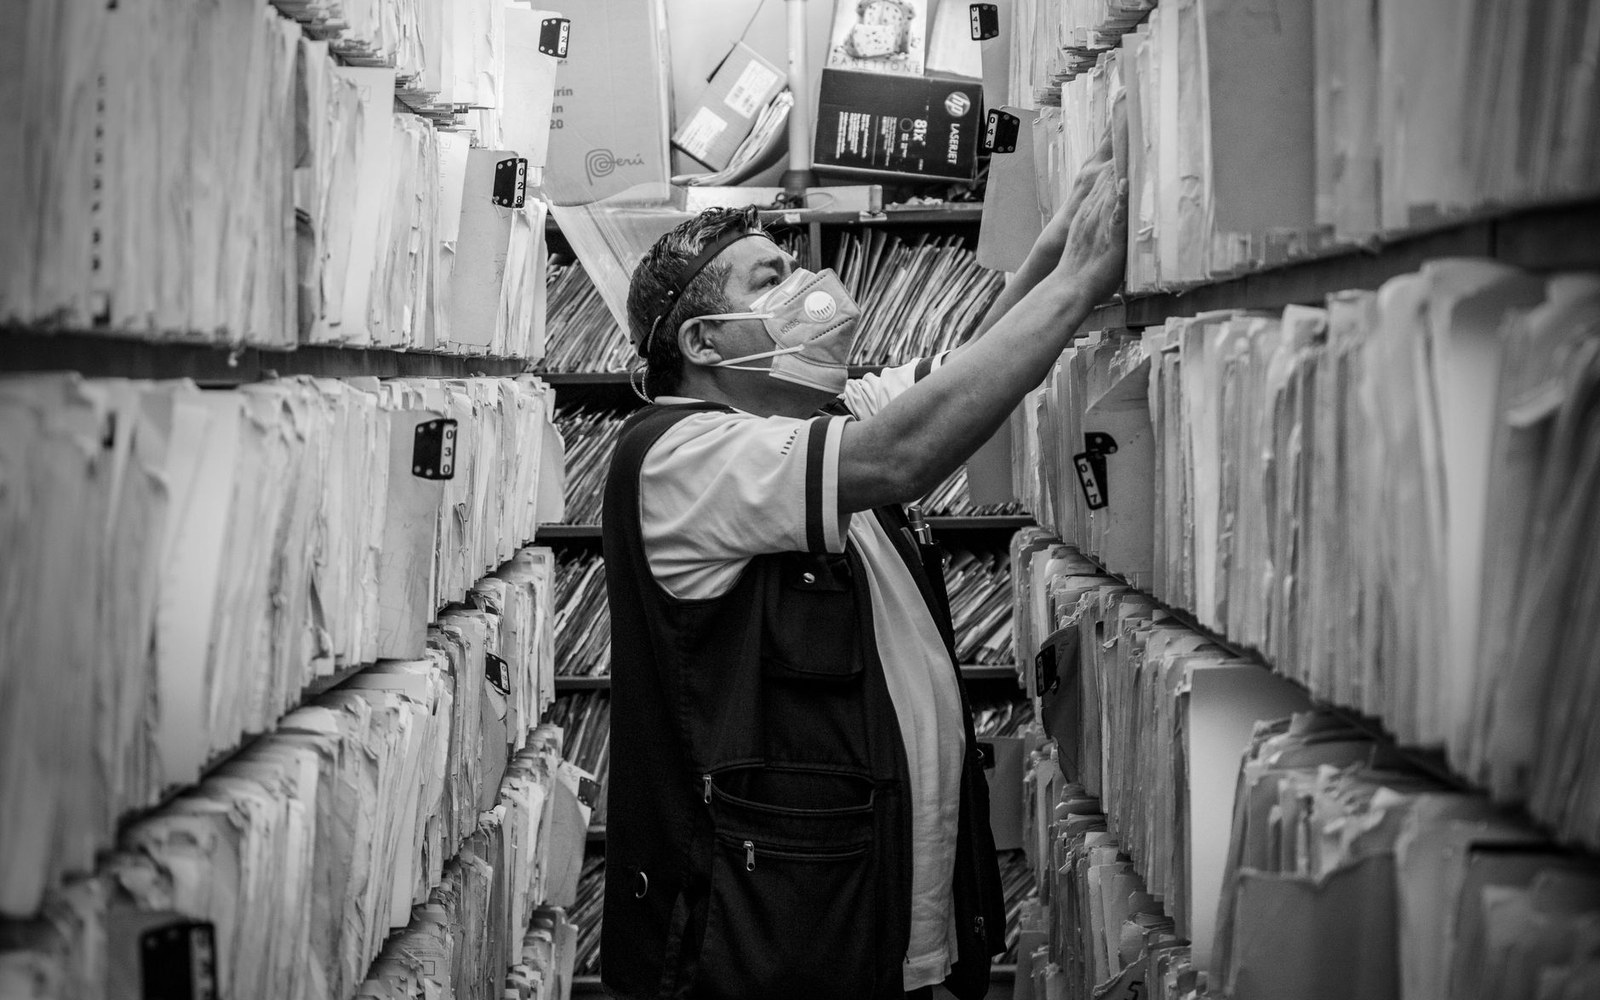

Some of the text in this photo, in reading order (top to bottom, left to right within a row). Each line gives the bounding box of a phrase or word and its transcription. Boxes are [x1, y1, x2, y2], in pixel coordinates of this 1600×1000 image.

[832, 56, 921, 74] PANETTONE
[944, 91, 972, 117] hp
[947, 123, 961, 165] LASERJET
[985, 116, 996, 148] 044
[585, 148, 645, 186] Perú
[443, 428, 454, 475] 030
[1079, 462, 1099, 504] 047
